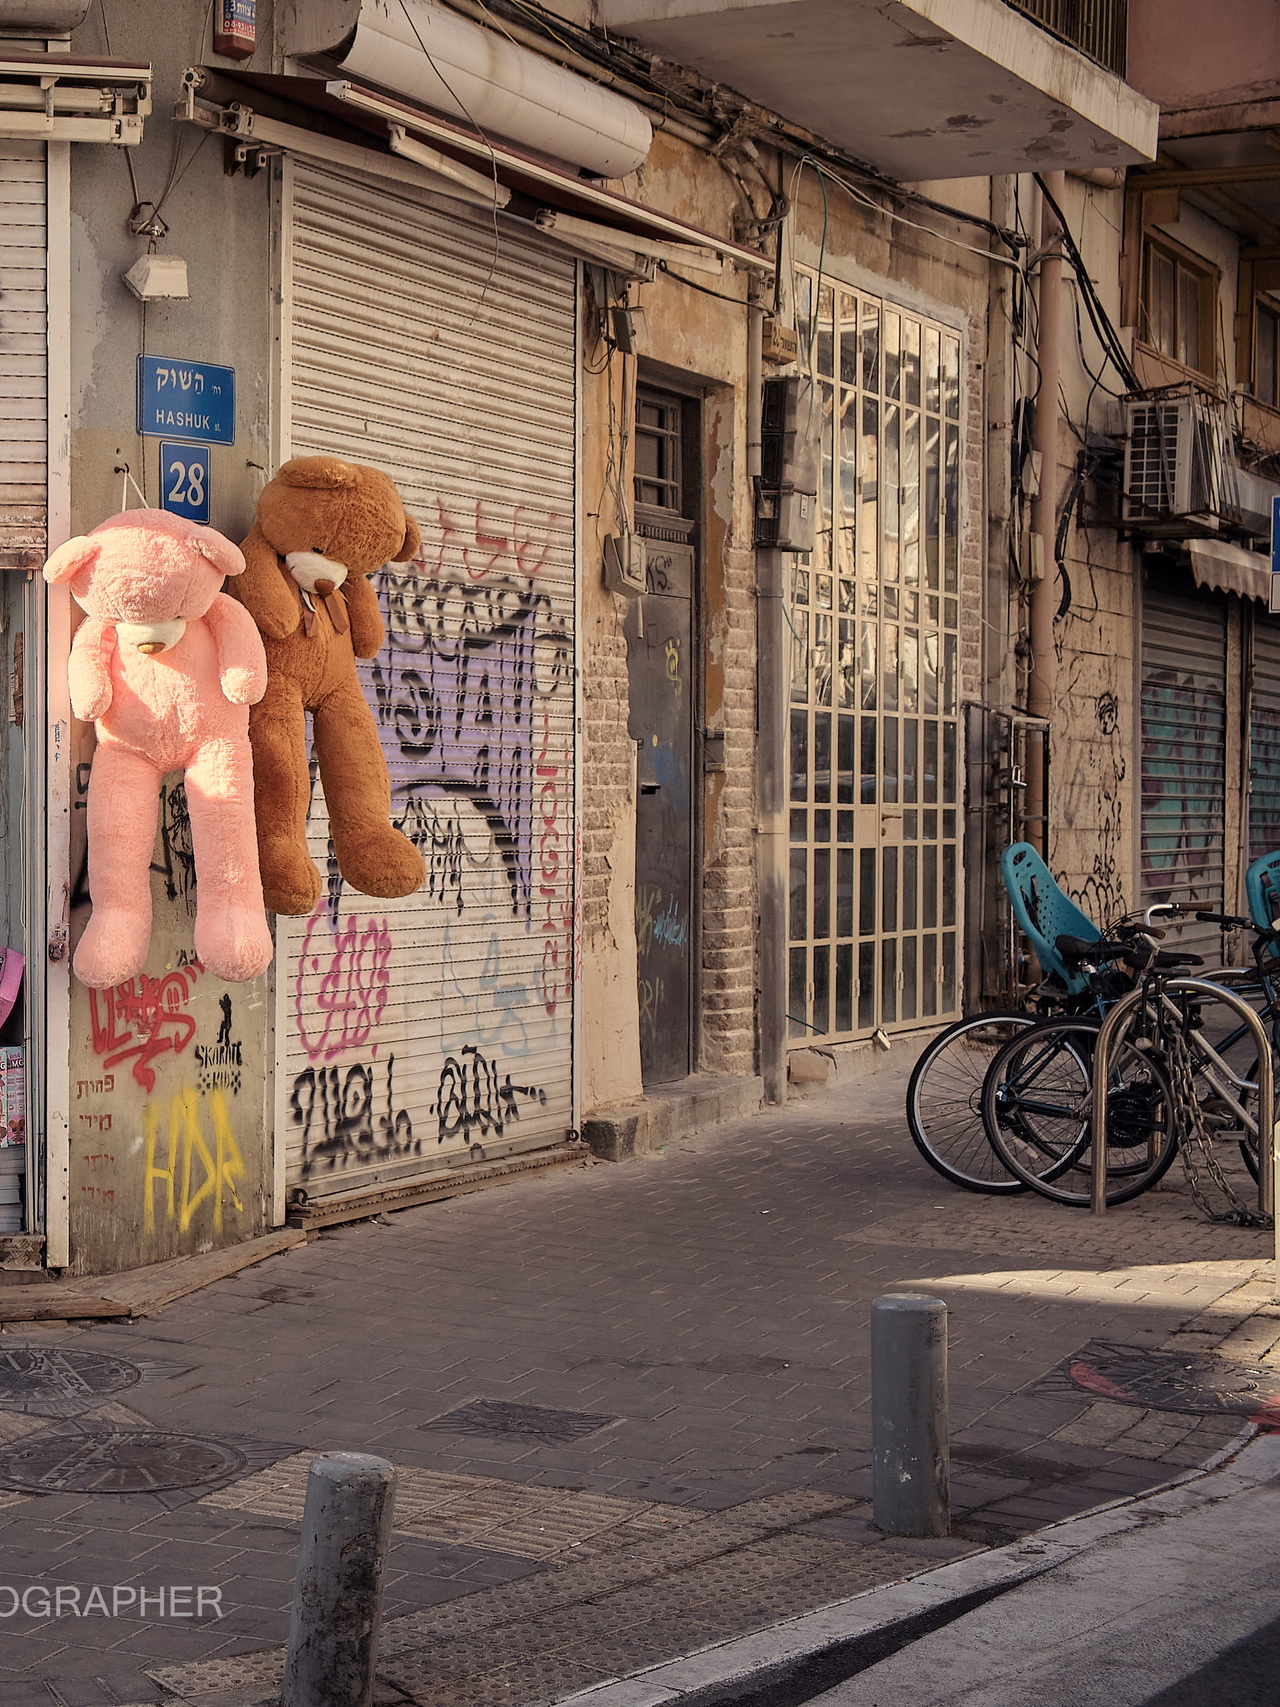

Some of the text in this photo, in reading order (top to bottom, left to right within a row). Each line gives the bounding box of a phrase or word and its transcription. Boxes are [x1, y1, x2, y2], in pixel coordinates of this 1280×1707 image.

[156, 409, 210, 430] HASHUK
[168, 461, 205, 507] 28
[76, 1074, 115, 1099] פחות
[79, 1113, 112, 1131] מידי
